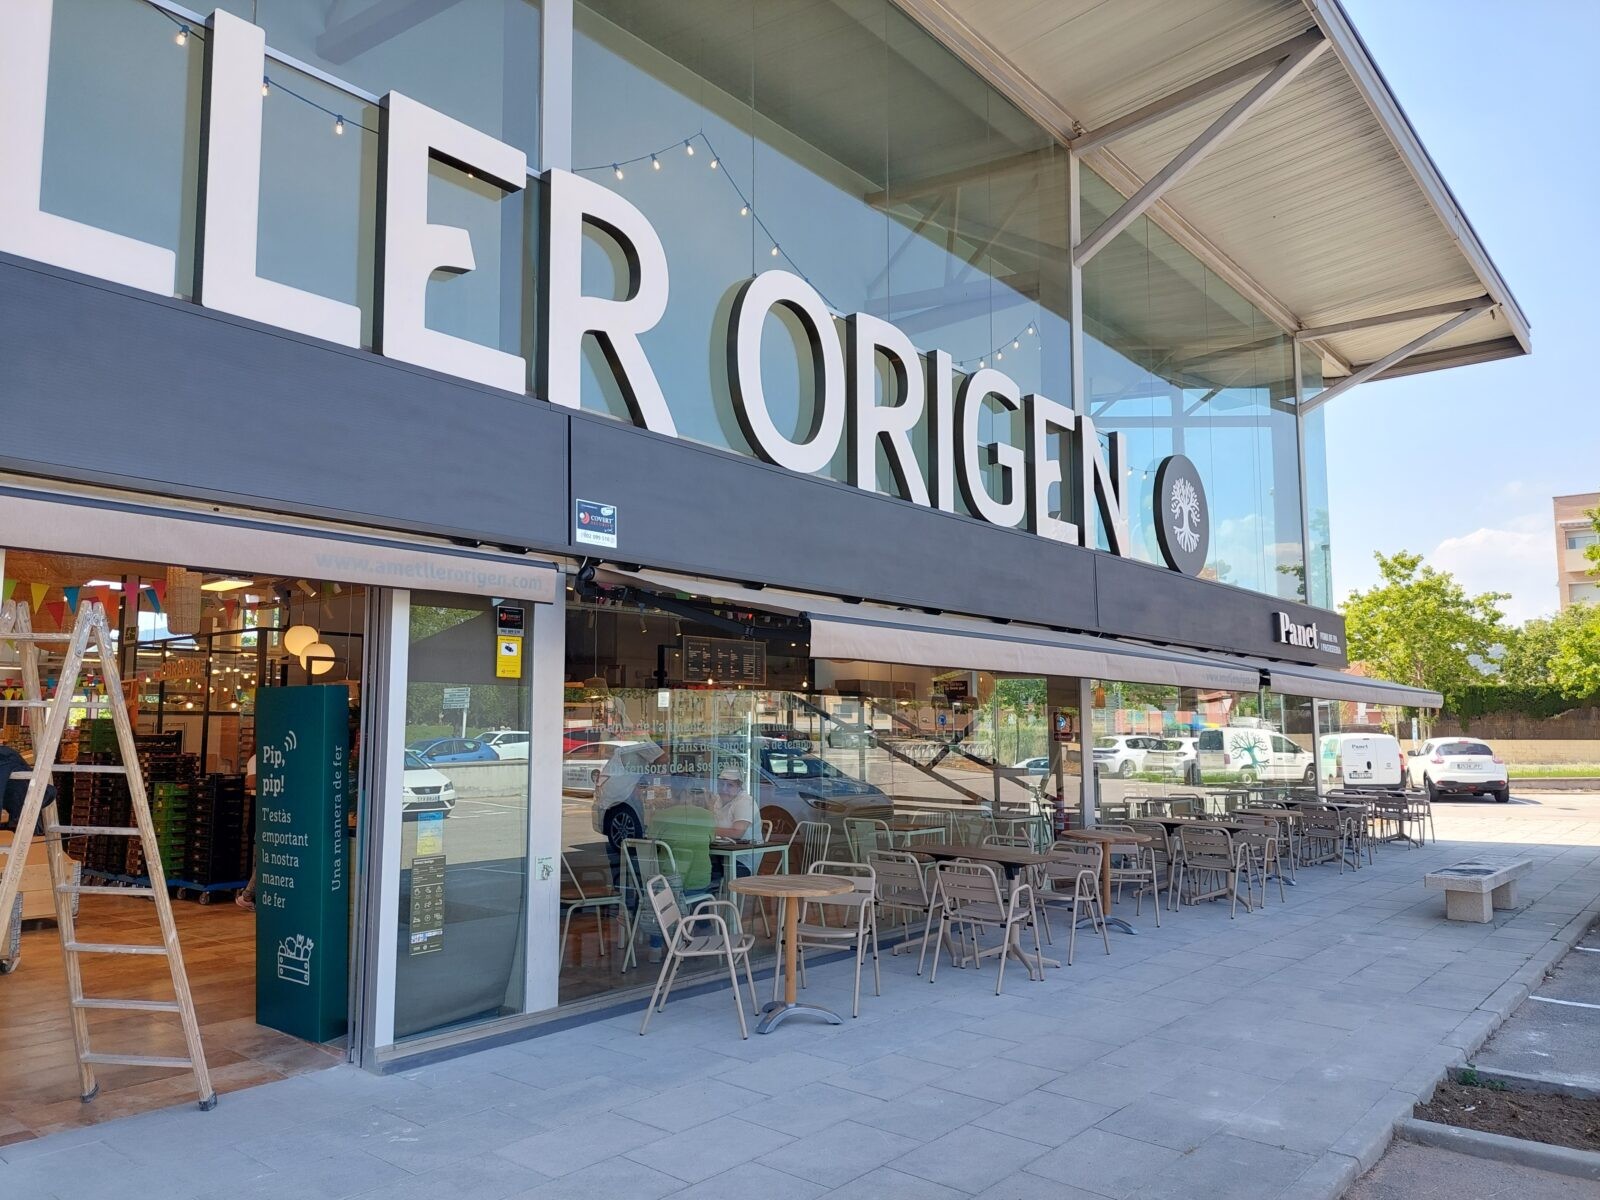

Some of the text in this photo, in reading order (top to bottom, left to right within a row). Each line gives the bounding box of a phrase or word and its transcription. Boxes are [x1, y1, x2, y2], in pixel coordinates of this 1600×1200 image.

[728, 270, 1129, 558] ORIGEN
[315, 553, 542, 590] www.ametllerorigen.com
[1276, 611, 1319, 649] Panet
[262, 744, 286, 769] Pip,
[262, 773, 285, 797] pip!
[261, 807, 292, 824] T'estàs
[331, 745, 343, 892] Una manera de fer
[261, 831, 309, 847] emportant
[262, 848, 299, 868] la nostra
[262, 872, 295, 889] manera
[262, 891, 286, 909] de fer
